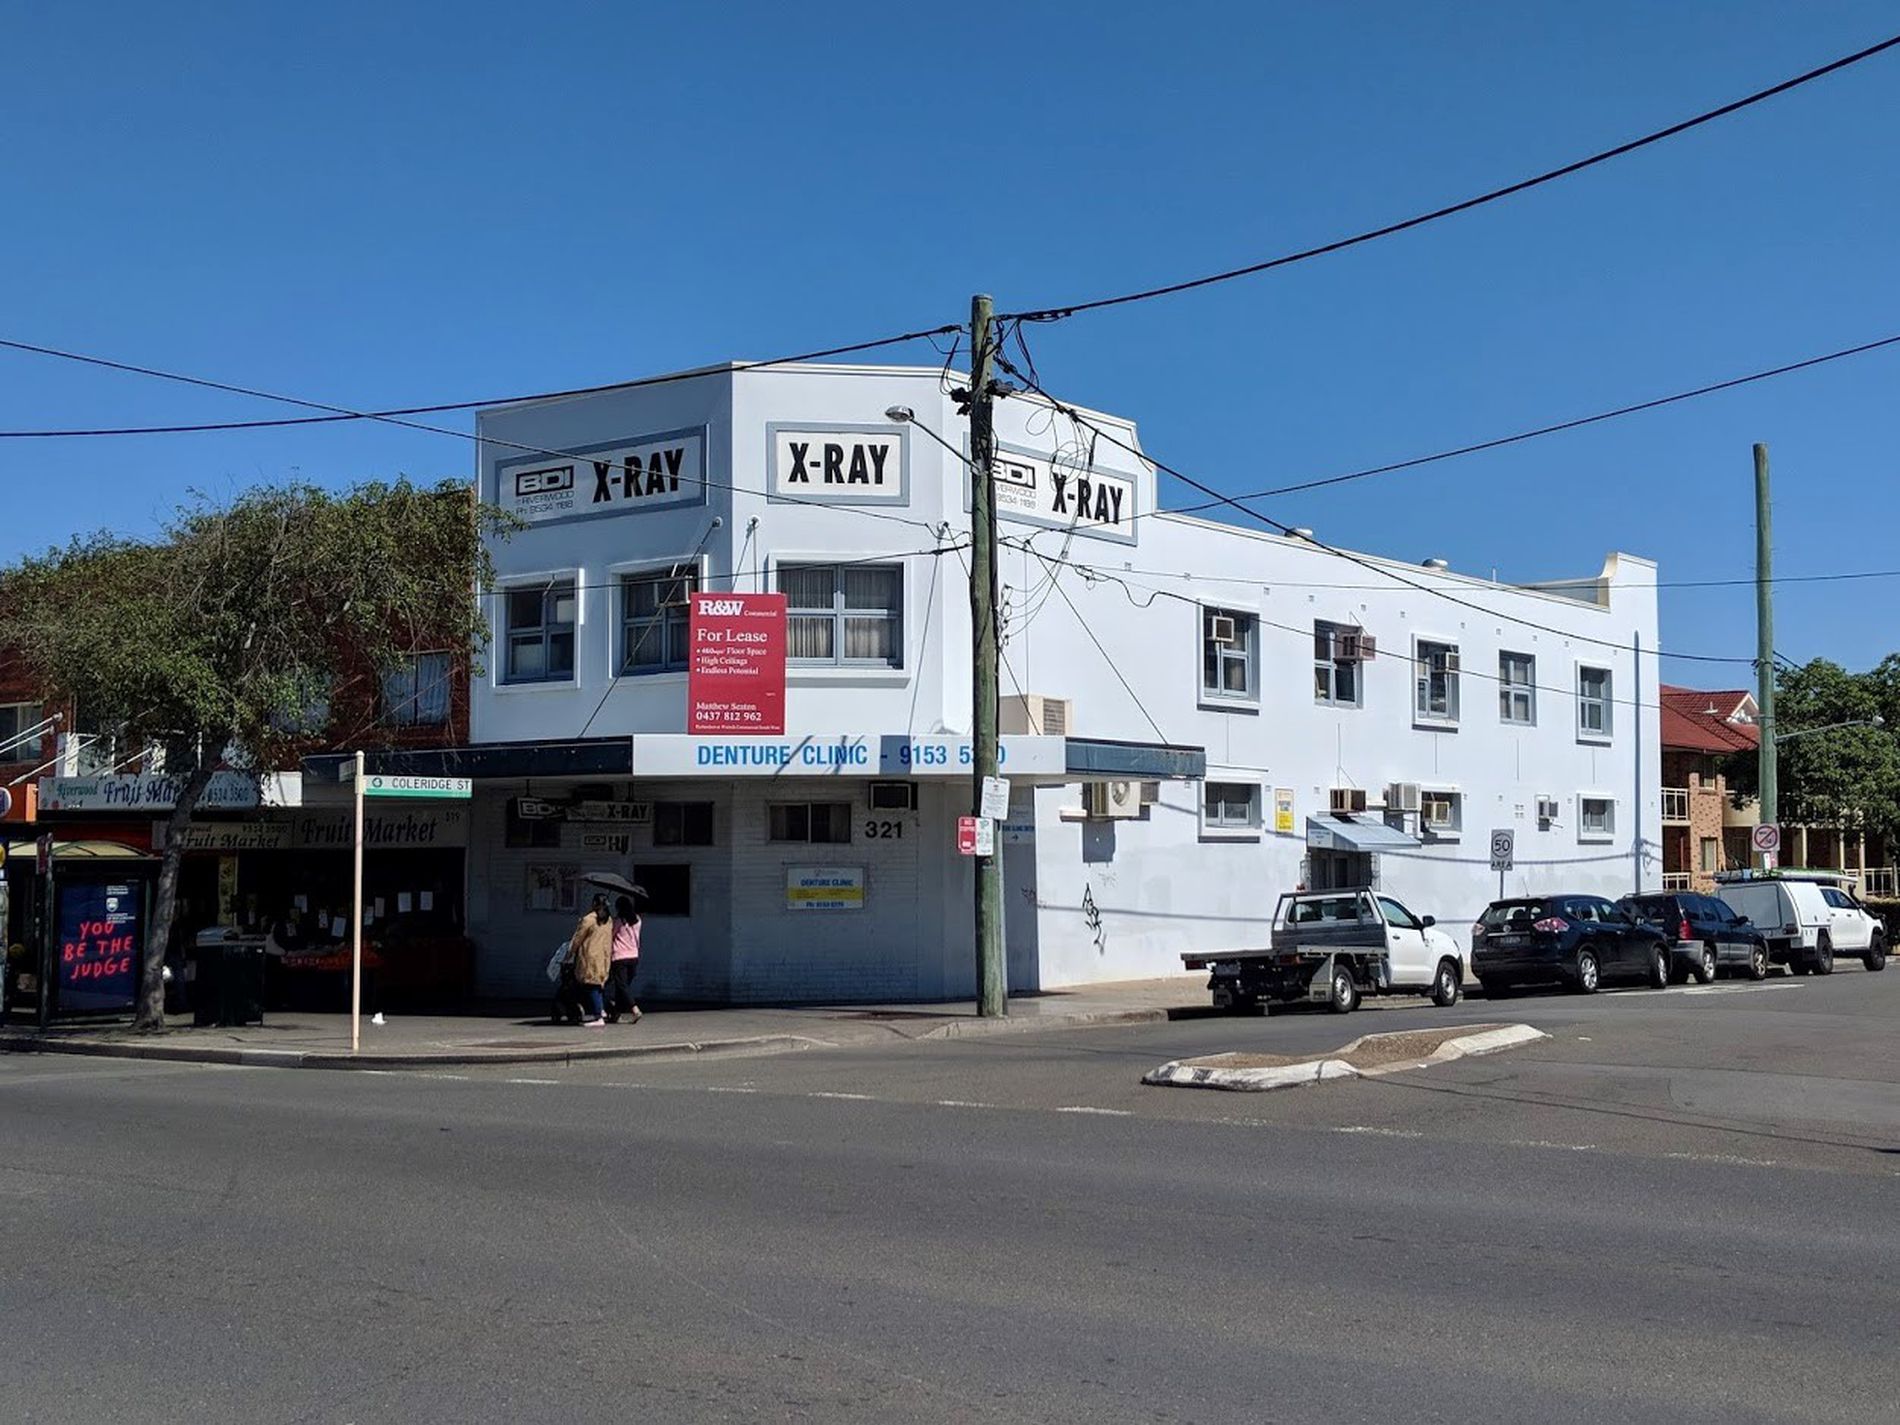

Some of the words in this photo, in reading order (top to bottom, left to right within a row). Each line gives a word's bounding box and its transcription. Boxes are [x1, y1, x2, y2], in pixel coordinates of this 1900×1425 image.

[788, 443, 890, 484] X-RAY
[518, 468, 572, 494] BDI
[593, 448, 684, 503] X-RAY
[522, 490, 574, 504] RIVERWOOD
[1052, 472, 1124, 524] X-RAY
[698, 600, 744, 616] R&W
[697, 629, 723, 642] For
[726, 629, 768, 642] Lease
[727, 647, 746, 656] Floor
[747, 647, 767, 657] Space
[701, 657, 719, 666] High
[720, 657, 748, 667] Ceilings
[702, 667, 728, 675] Endless
[729, 667, 759, 675] Potential
[696, 702, 729, 711] Matthew
[696, 712, 720, 721] 0437
[724, 712, 741, 721] 812
[744, 712, 762, 721] 962
[698, 746, 790, 765] DENTURE
[803, 746, 867, 765] CLINIC
[901, 746, 946, 765] 9153
[392, 778, 452, 790] COLERIDGE
[457, 780, 471, 791] ST
[608, 804, 648, 819] X-RAY
[303, 816, 353, 843] Fruit
[364, 814, 437, 843] Market
[866, 821, 903, 839] 321
[221, 833, 280, 849] Market
[1495, 839, 1510, 851] 50
[79, 920, 115, 940] YOU
[64, 942, 87, 961] BE
[96, 935, 133, 956] THE
[70, 957, 130, 979] JUDGE
